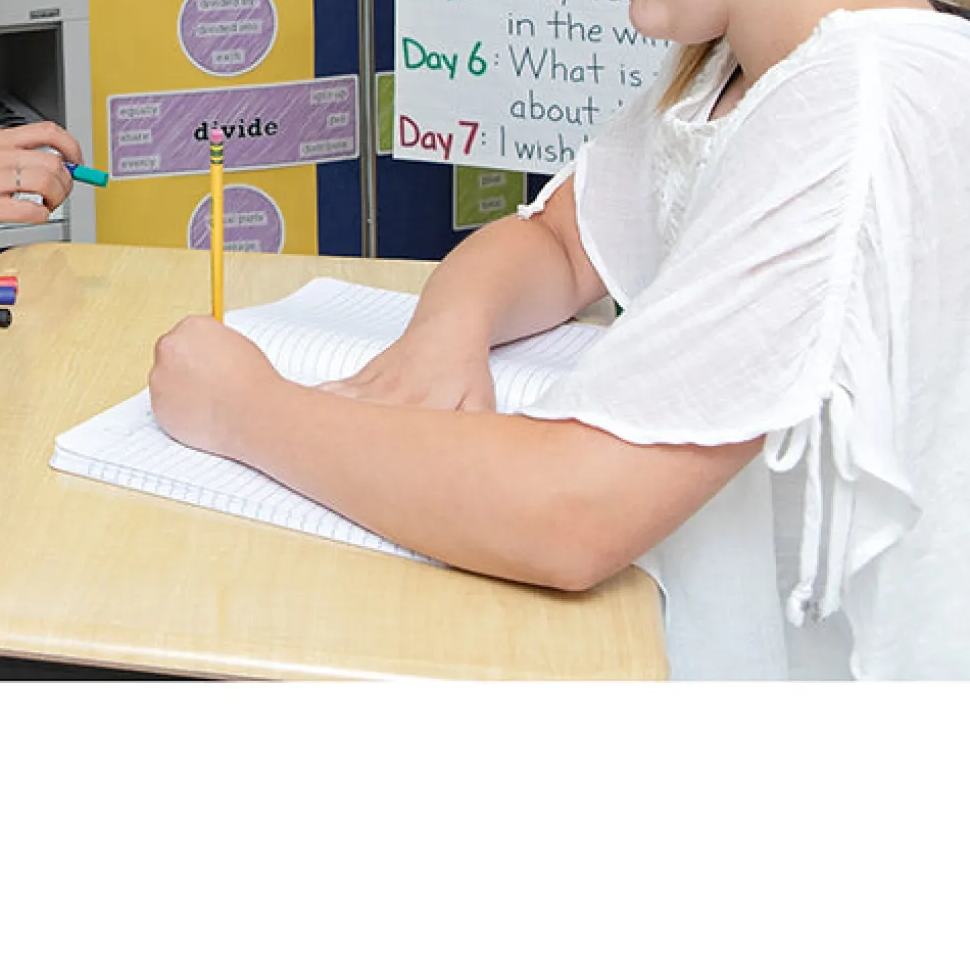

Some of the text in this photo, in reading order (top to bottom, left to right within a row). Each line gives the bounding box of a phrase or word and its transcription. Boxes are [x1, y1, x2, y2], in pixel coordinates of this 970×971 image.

[508, 11, 536, 36] in
[547, 10, 603, 42] the
[402, 37, 458, 79] Day
[508, 43, 605, 84] What
[620, 64, 642, 87] is
[510, 90, 600, 126] about
[399, 115, 453, 161] Day
[500, 125, 506, 157] I
[514, 134, 575, 163] wish
